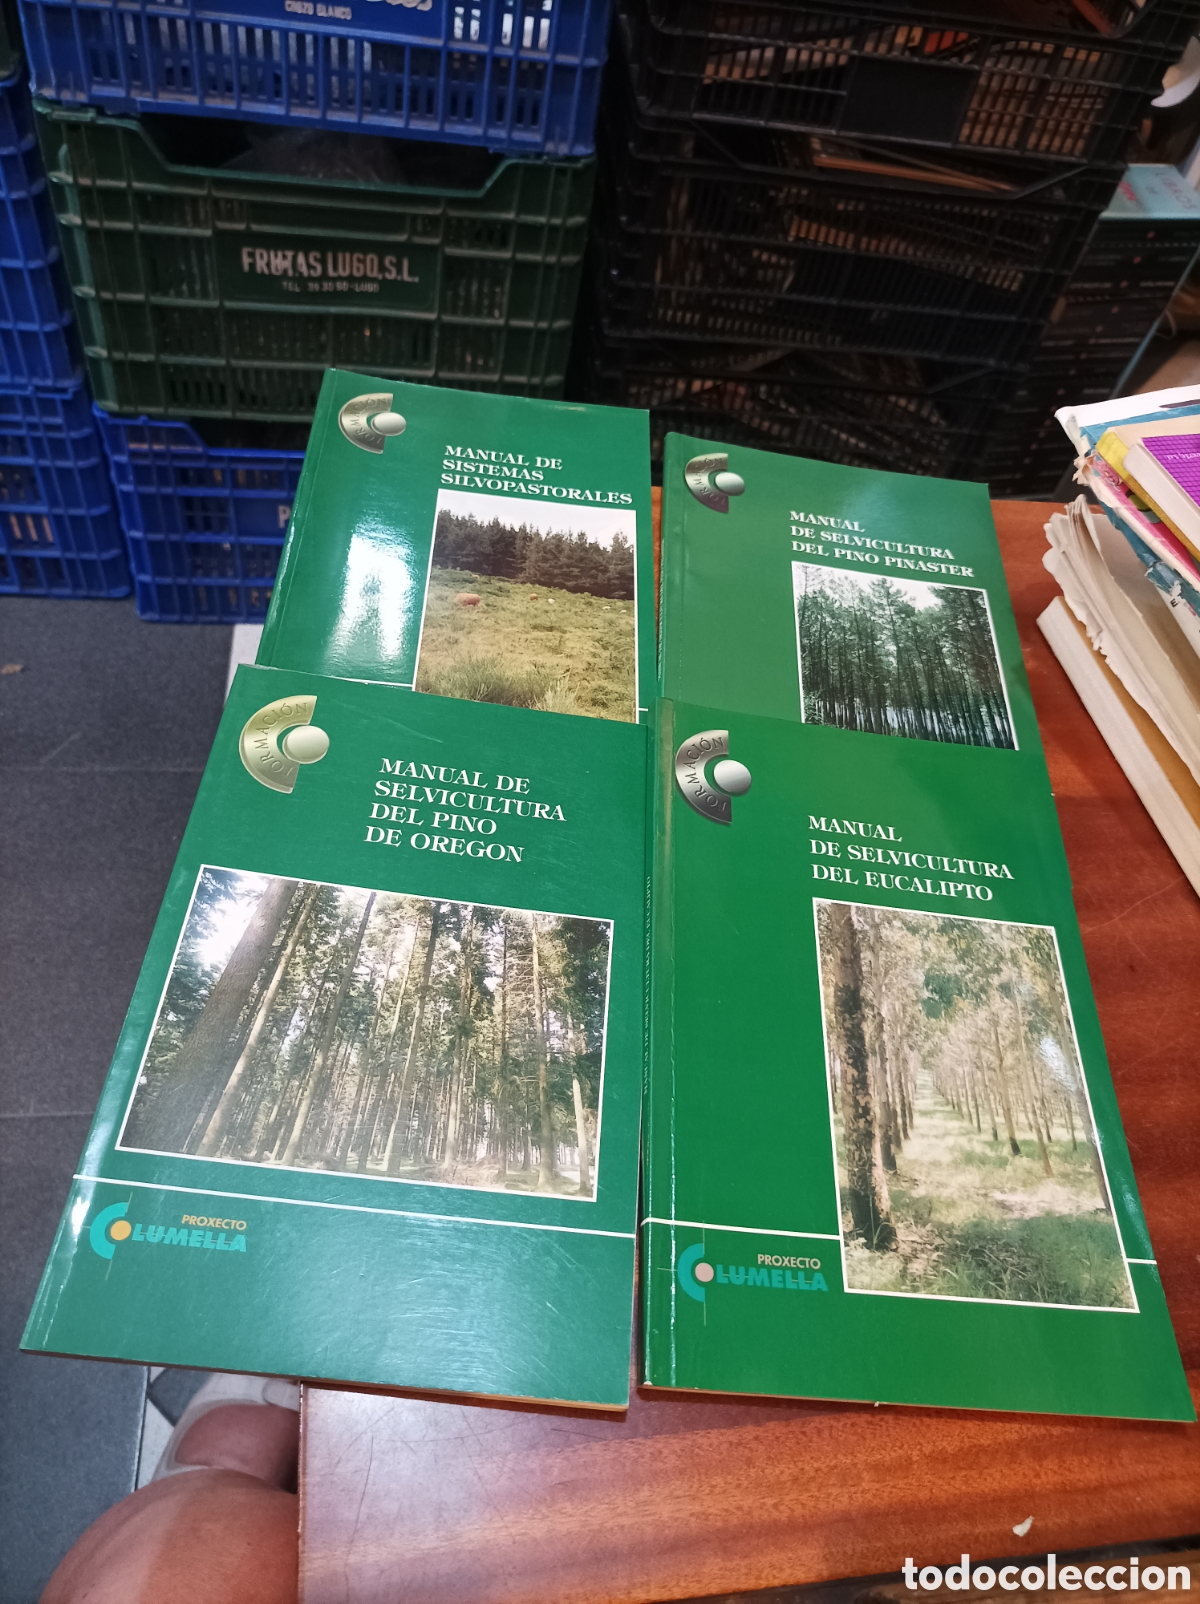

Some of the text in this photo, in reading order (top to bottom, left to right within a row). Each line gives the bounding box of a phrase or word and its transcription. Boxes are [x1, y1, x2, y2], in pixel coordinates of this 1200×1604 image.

[241, 246, 323, 278] FRUTAS
[442, 459, 544, 481] SISTEMAS
[444, 445, 563, 471] MANUAL DE
[440, 473, 633, 505] SILVOPASTORALES
[789, 510, 865, 533] MANUAL
[790, 525, 955, 560] DE SELVICULTURA
[791, 541, 975, 578] DEL PINO PINASTER
[379, 757, 531, 795] MANUAL DE
[374, 780, 567, 822] SELVICULTURA
[369, 802, 498, 835] DEL PINO
[807, 815, 902, 842] MANUAL
[363, 825, 525, 863] DE OREGON
[808, 839, 1015, 880] DE SELVICULTURA
[811, 864, 993, 901] DEL EUCALIPTO
[181, 1214, 247, 1231] PROXECTO
[757, 1253, 821, 1270] PROXECTO
